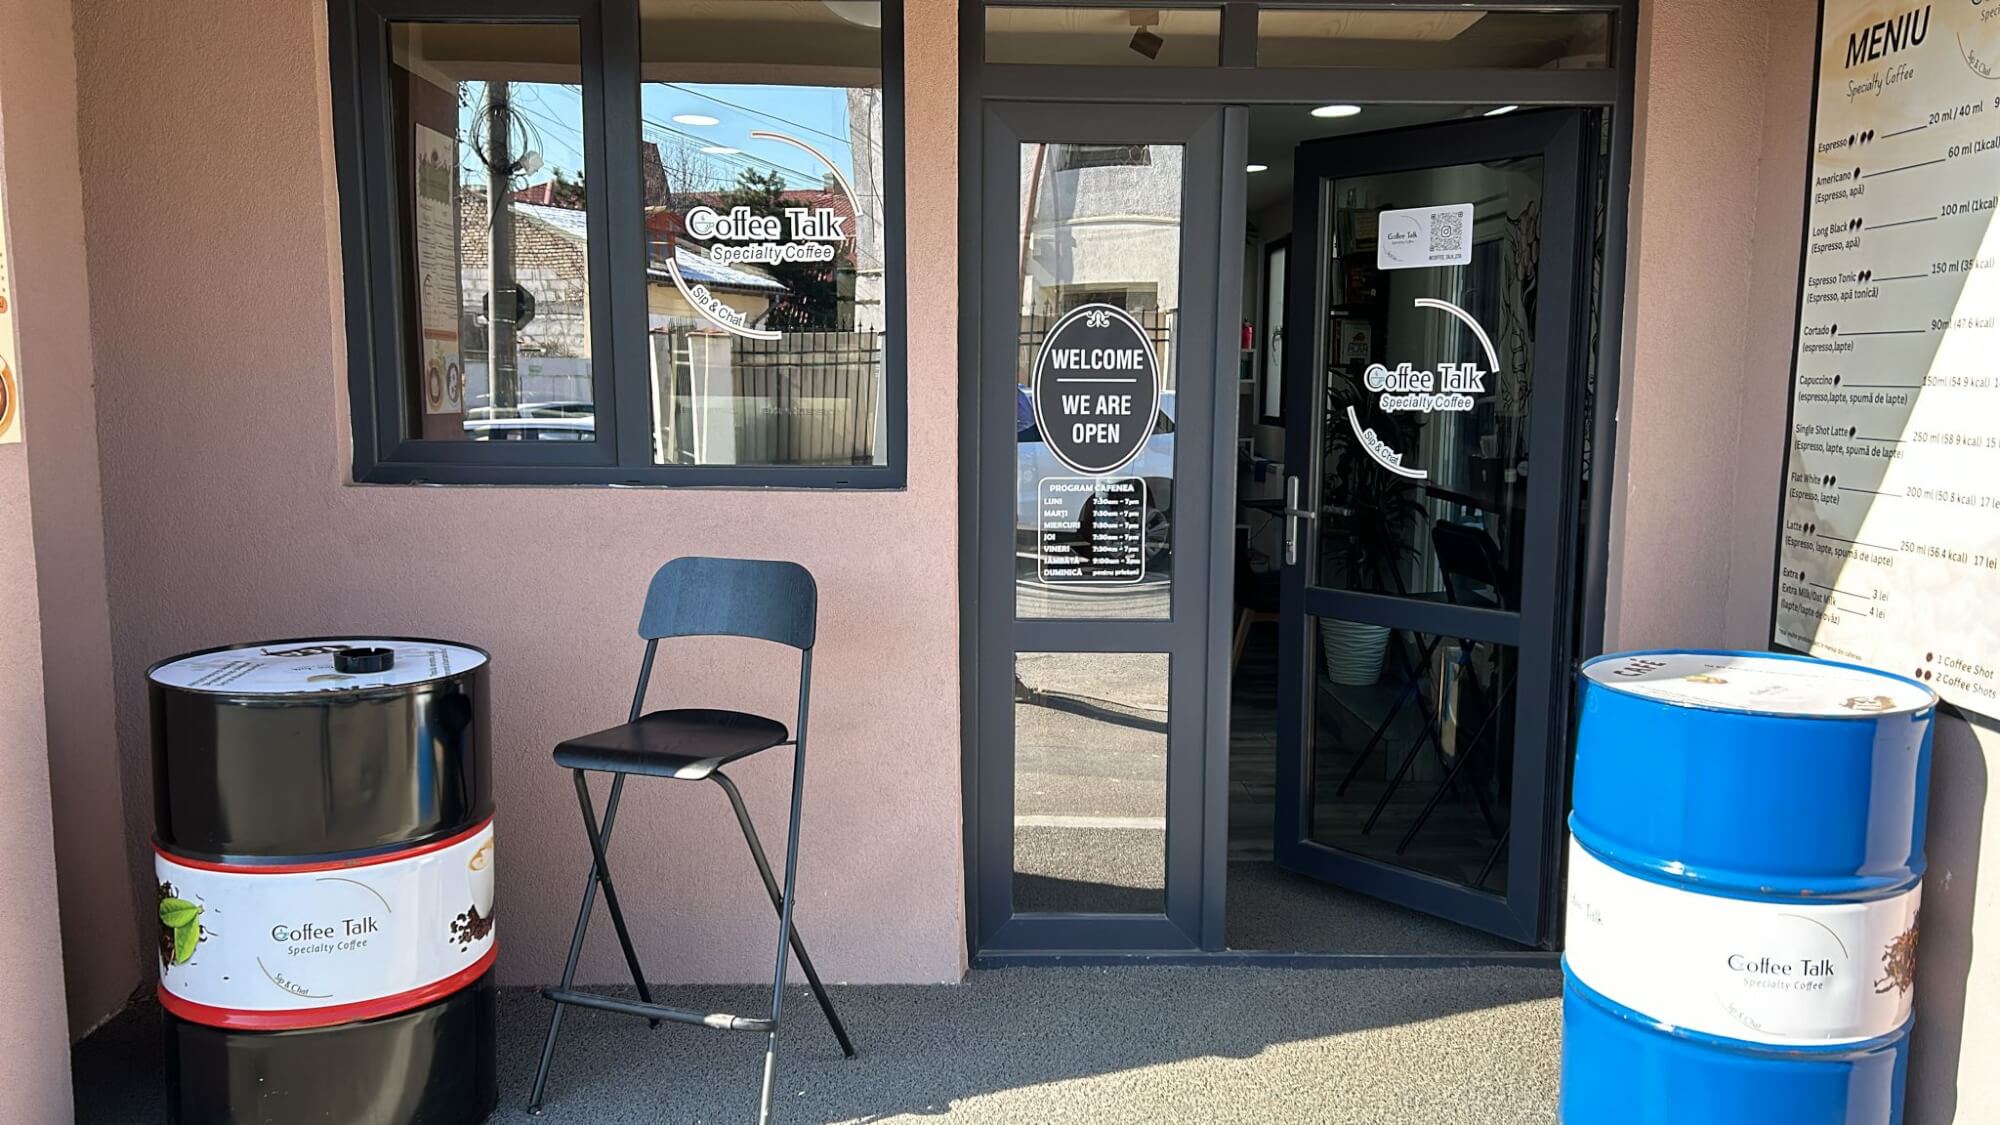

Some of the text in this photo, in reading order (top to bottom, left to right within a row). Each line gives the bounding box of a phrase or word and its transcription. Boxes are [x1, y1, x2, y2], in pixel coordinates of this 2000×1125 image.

[1845, 5, 1932, 69] MENIU
[1846, 63, 1914, 104] Specialty Coffee
[1818, 101, 1983, 153] Espresso 20 ml / 40 ml
[1816, 170, 1852, 187] Americano
[1948, 146, 1960, 158] 60
[1961, 143, 1972, 155] ml
[1814, 189, 1848, 205] (Espresso,
[687, 207, 845, 238] Coffee Talk
[1812, 225, 1829, 238] Long
[1829, 222, 1848, 234] Black
[1941, 203, 1958, 217] 100
[1959, 201, 1970, 214] ml
[713, 244, 832, 263] Specialty Coffee
[1811, 240, 1844, 254] (Espresso,
[1808, 275, 1837, 288] Espresso
[1838, 273, 1856, 284] Tonic
[1931, 262, 1947, 275] 150
[1948, 261, 1959, 273] ml
[693, 287, 745, 327] Sip & Chat
[1807, 291, 1840, 304] (Espresso,
[1803, 326, 1830, 336] Cortado
[1051, 349, 1144, 370] WELCOME
[1366, 364, 1485, 391] Coffee Talk
[1800, 375, 1832, 387] Capuccino
[1062, 395, 1131, 415] WE ARE
[1381, 396, 1472, 410] Specialty Coffee
[1874, 394, 1885, 404] de
[1885, 393, 1908, 406] lapte)
[1072, 423, 1120, 443] OPEN
[1795, 424, 1815, 436] Single
[1815, 426, 1829, 437] Shot
[1830, 427, 1848, 437] Latte
[1913, 432, 1928, 443] 250
[1929, 432, 1940, 443] ml
[1364, 430, 1401, 465] Sip & Chat
[1794, 440, 1825, 452] (Espresso,
[1871, 447, 1881, 457] de
[1050, 484, 1135, 492] PROGRAM CAFENEA
[1789, 488, 1840, 506] (Espresso, lapte)
[1791, 472, 1803, 484] Flat
[1803, 474, 1821, 485] White
[1906, 486, 1923, 498] 200
[1924, 488, 1934, 500] ml
[1980, 497, 1990, 508] 17
[1124, 498, 1139, 506] 7pm
[1124, 510, 1139, 518] 7pm
[1124, 522, 1139, 530] 7pm
[1785, 536, 1814, 551] (Espresso,
[1859, 551, 1869, 562] de
[1870, 552, 1893, 567] lapte)
[1786, 520, 1802, 530] Latte
[1900, 541, 1915, 553] 250
[1917, 544, 1926, 556] ml
[1948, 549, 1968, 565] kcal)
[1974, 555, 1984, 567] 17
[1985, 557, 1998, 570] lei
[1783, 567, 1889, 602] Extra 3 lei
[1782, 583, 1798, 596] Extra
[1869, 606, 1875, 616] 4
[1876, 608, 1886, 619] lei
[1937, 654, 1994, 680] 1 Coffee Shot
[1935, 671, 1997, 698] 2 Coffee Shots
[272, 916, 378, 942] Coffee Talk
[288, 939, 368, 957] Specialty Coffee
[1727, 954, 1835, 977] Coffee Talk
[274, 973, 285, 985] Sip
[291, 984, 310, 996] Chat
[1743, 977, 1824, 992] Specialty Coffee
